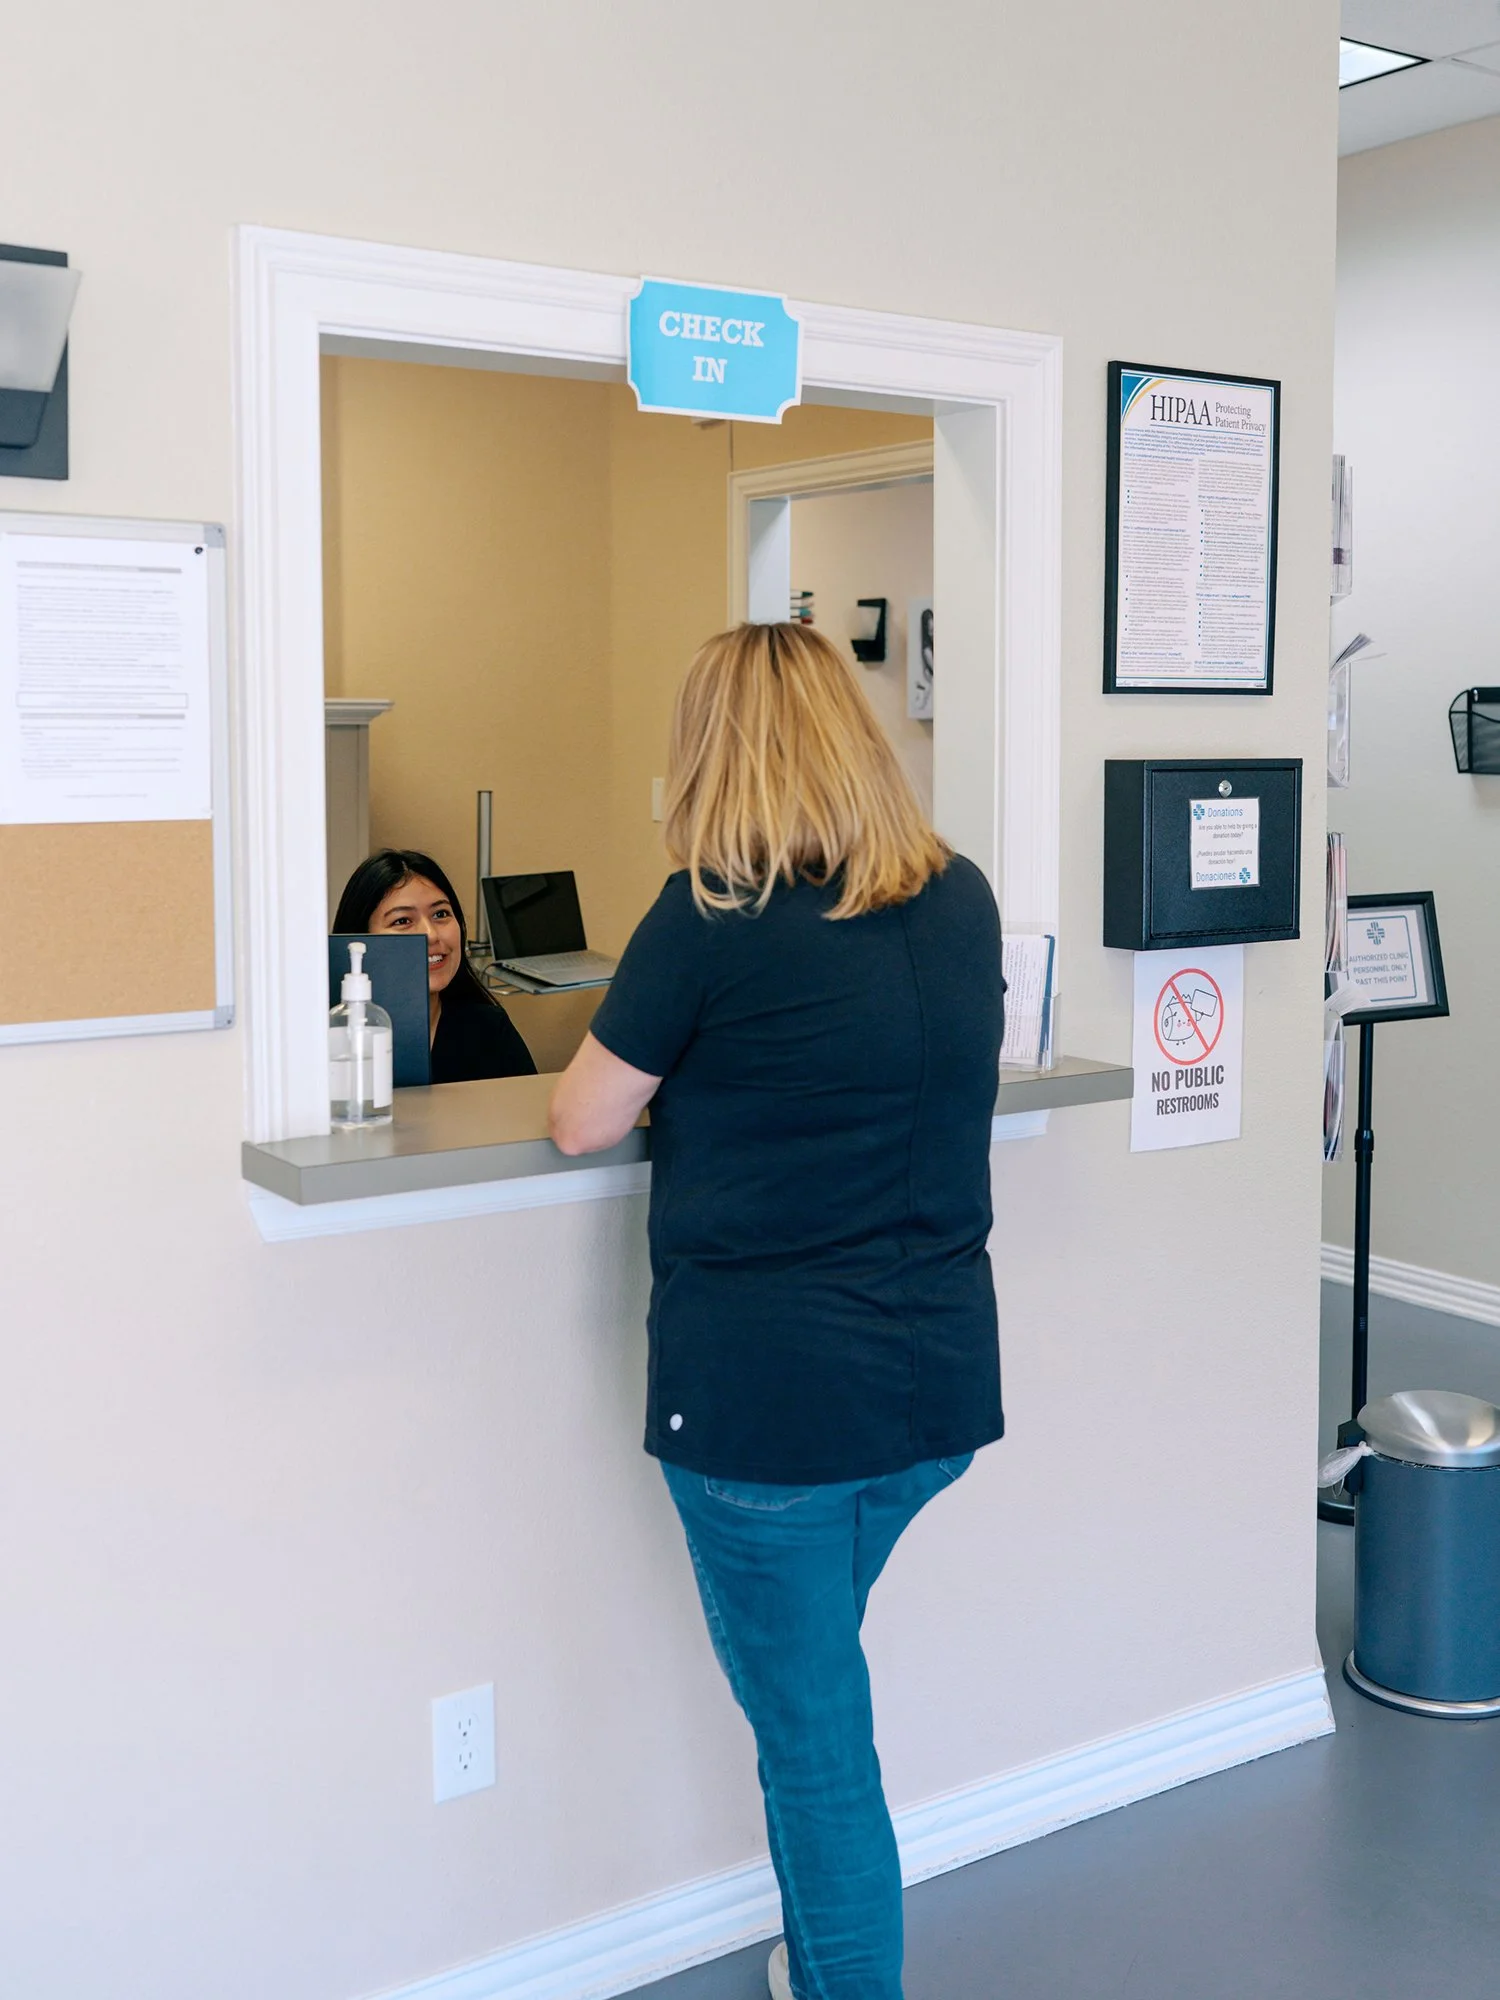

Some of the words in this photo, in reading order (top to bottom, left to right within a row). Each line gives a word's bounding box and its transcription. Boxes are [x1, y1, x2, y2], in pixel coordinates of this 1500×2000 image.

[658, 310, 765, 347] CHECK
[692, 355, 728, 384] IN
[1150, 394, 1212, 426] HIPAA
[1215, 402, 1252, 418] Protecting
[1215, 416, 1240, 429] Patient
[1241, 421, 1266, 434] Privacy
[1207, 807, 1244, 817] Donations
[1230, 831, 1244, 839] today?
[1195, 871, 1236, 882] Donaciones
[1349, 953, 1388, 962] AUTHORIZED
[1389, 951, 1409, 960] CLINIC
[1353, 965, 1390, 974] PERSONNEL
[1391, 963, 1407, 972] ONLY
[1374, 976, 1388, 984] THIS
[1389, 975, 1408, 984] POINT
[1151, 1071, 1170, 1093] NO
[1175, 1064, 1224, 1090] PUBLIC
[1156, 1092, 1219, 1116] RESTROOMS
